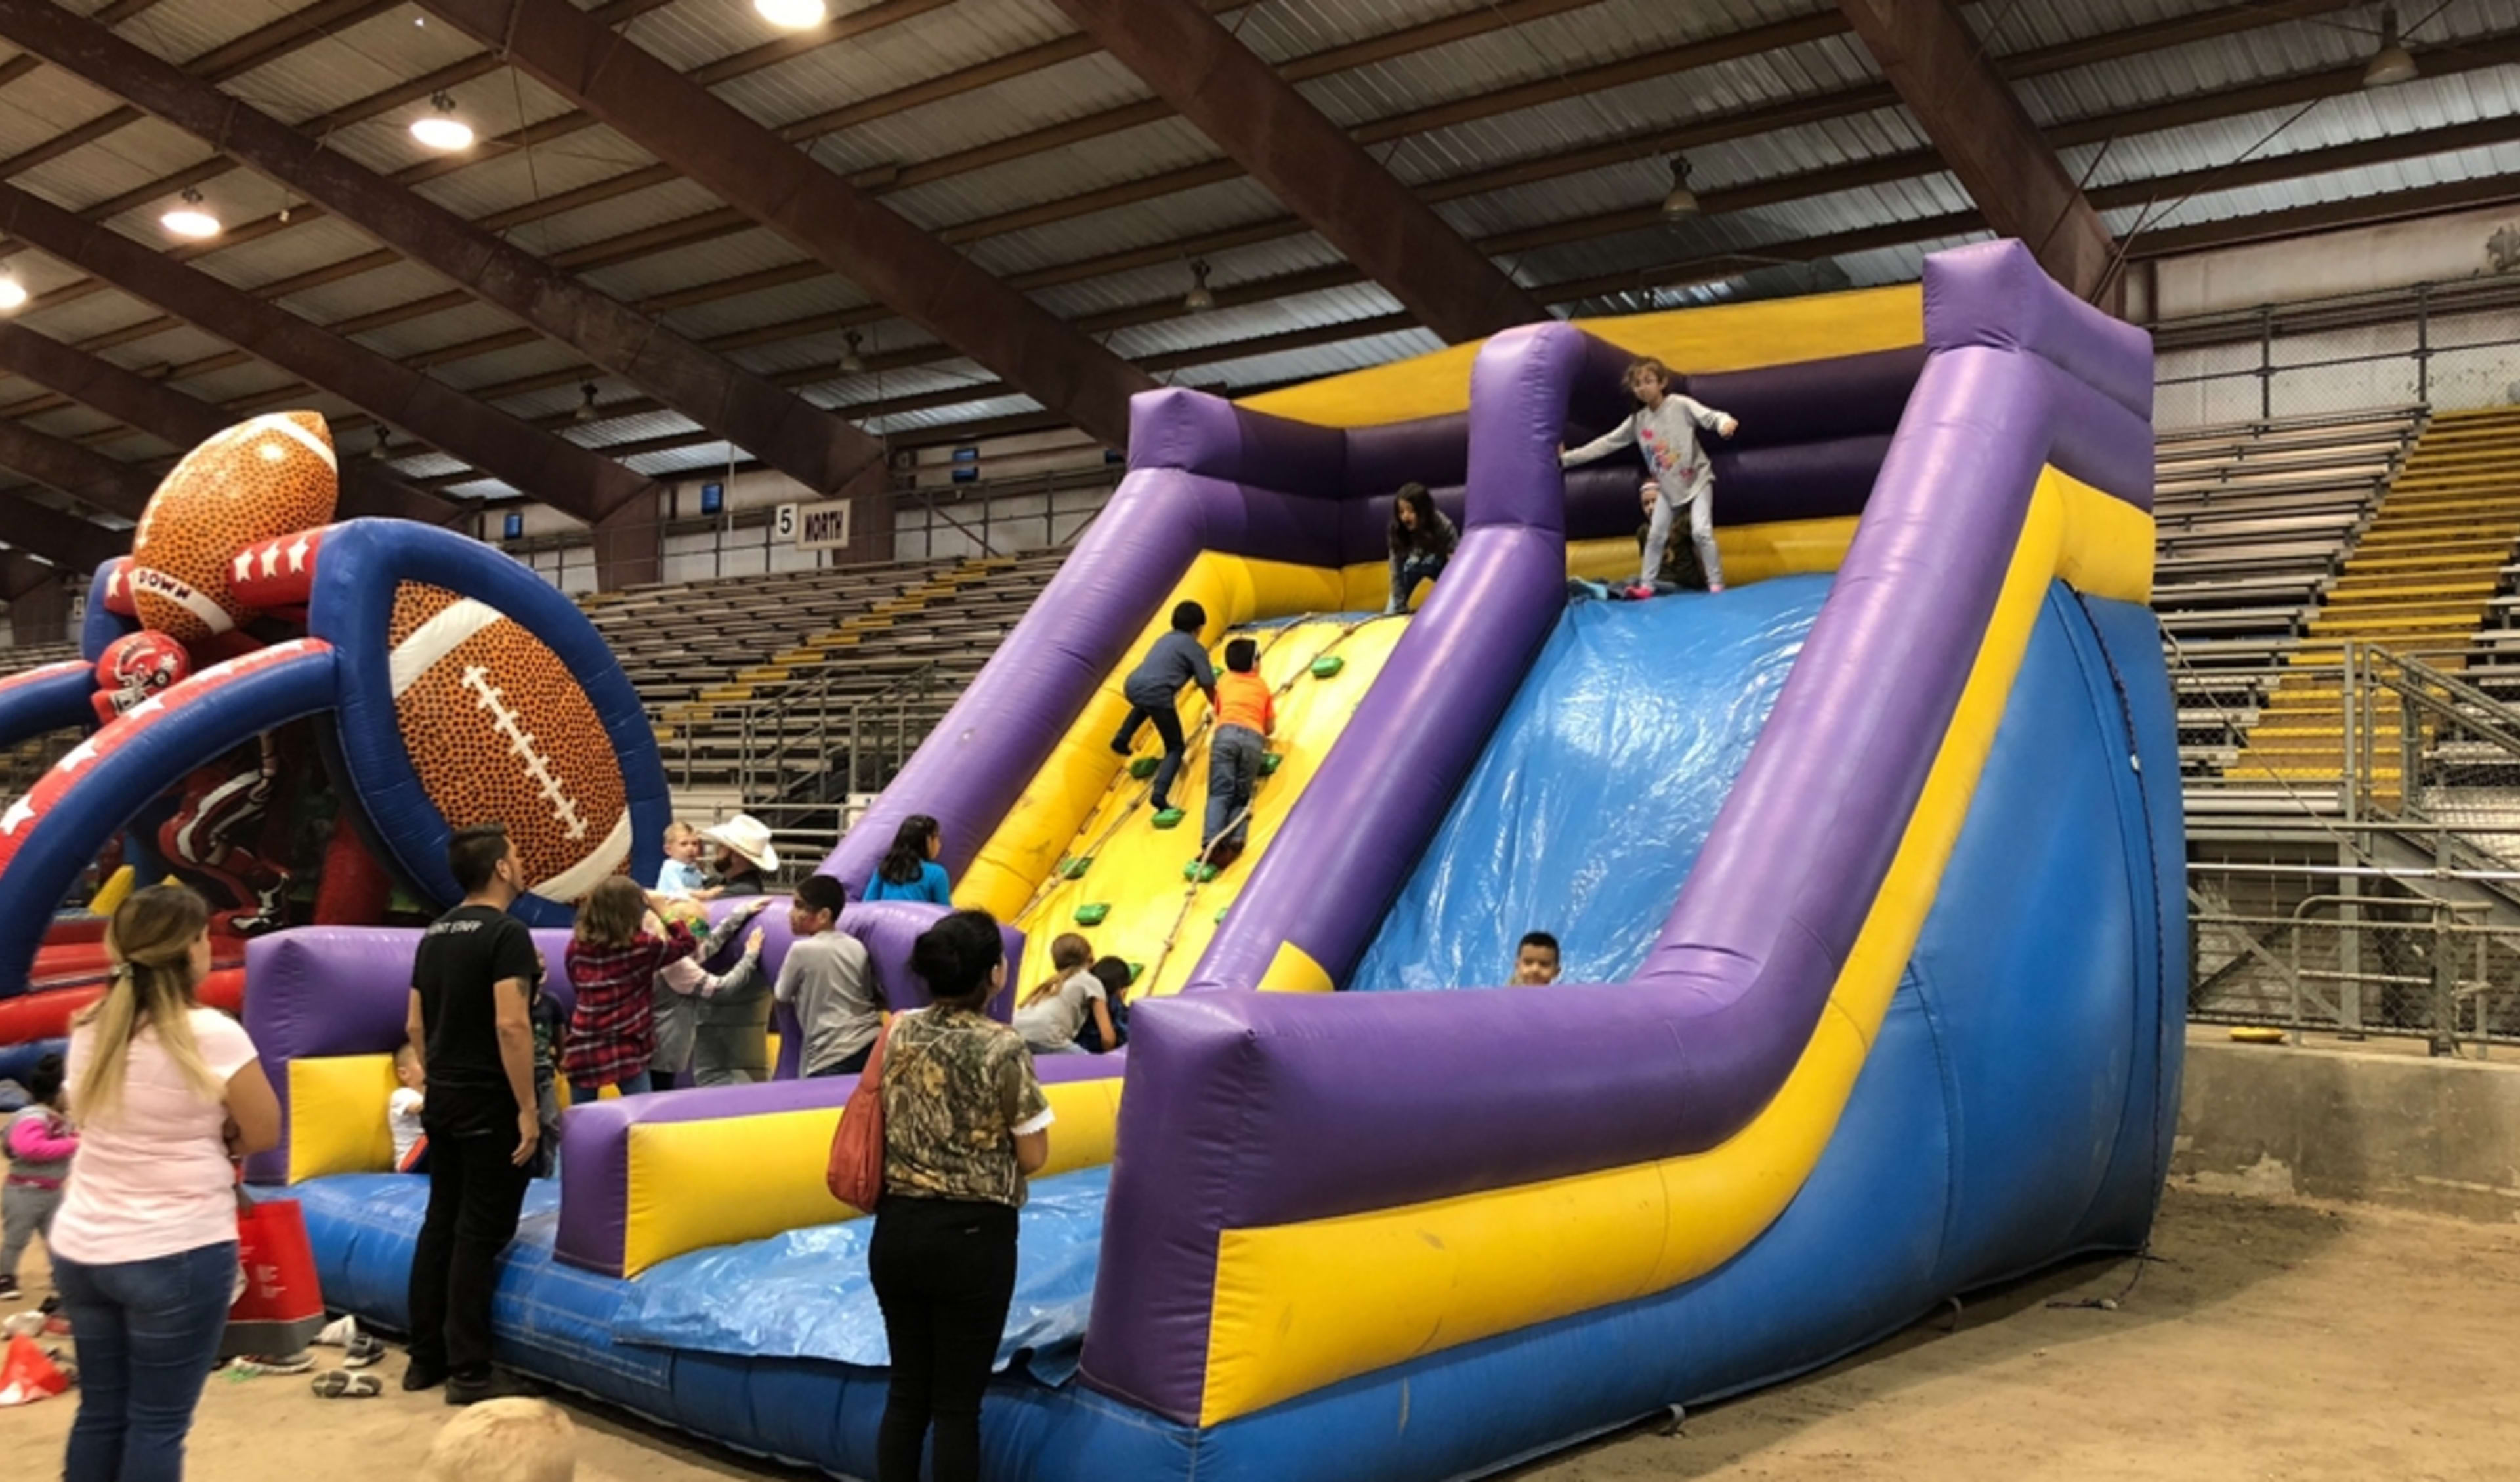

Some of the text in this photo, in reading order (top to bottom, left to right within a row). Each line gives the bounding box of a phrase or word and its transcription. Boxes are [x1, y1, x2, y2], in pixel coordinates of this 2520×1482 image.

[780, 507, 792, 534] 5
[805, 511, 843, 542] NORTH
[138, 570, 191, 600] DOWN
